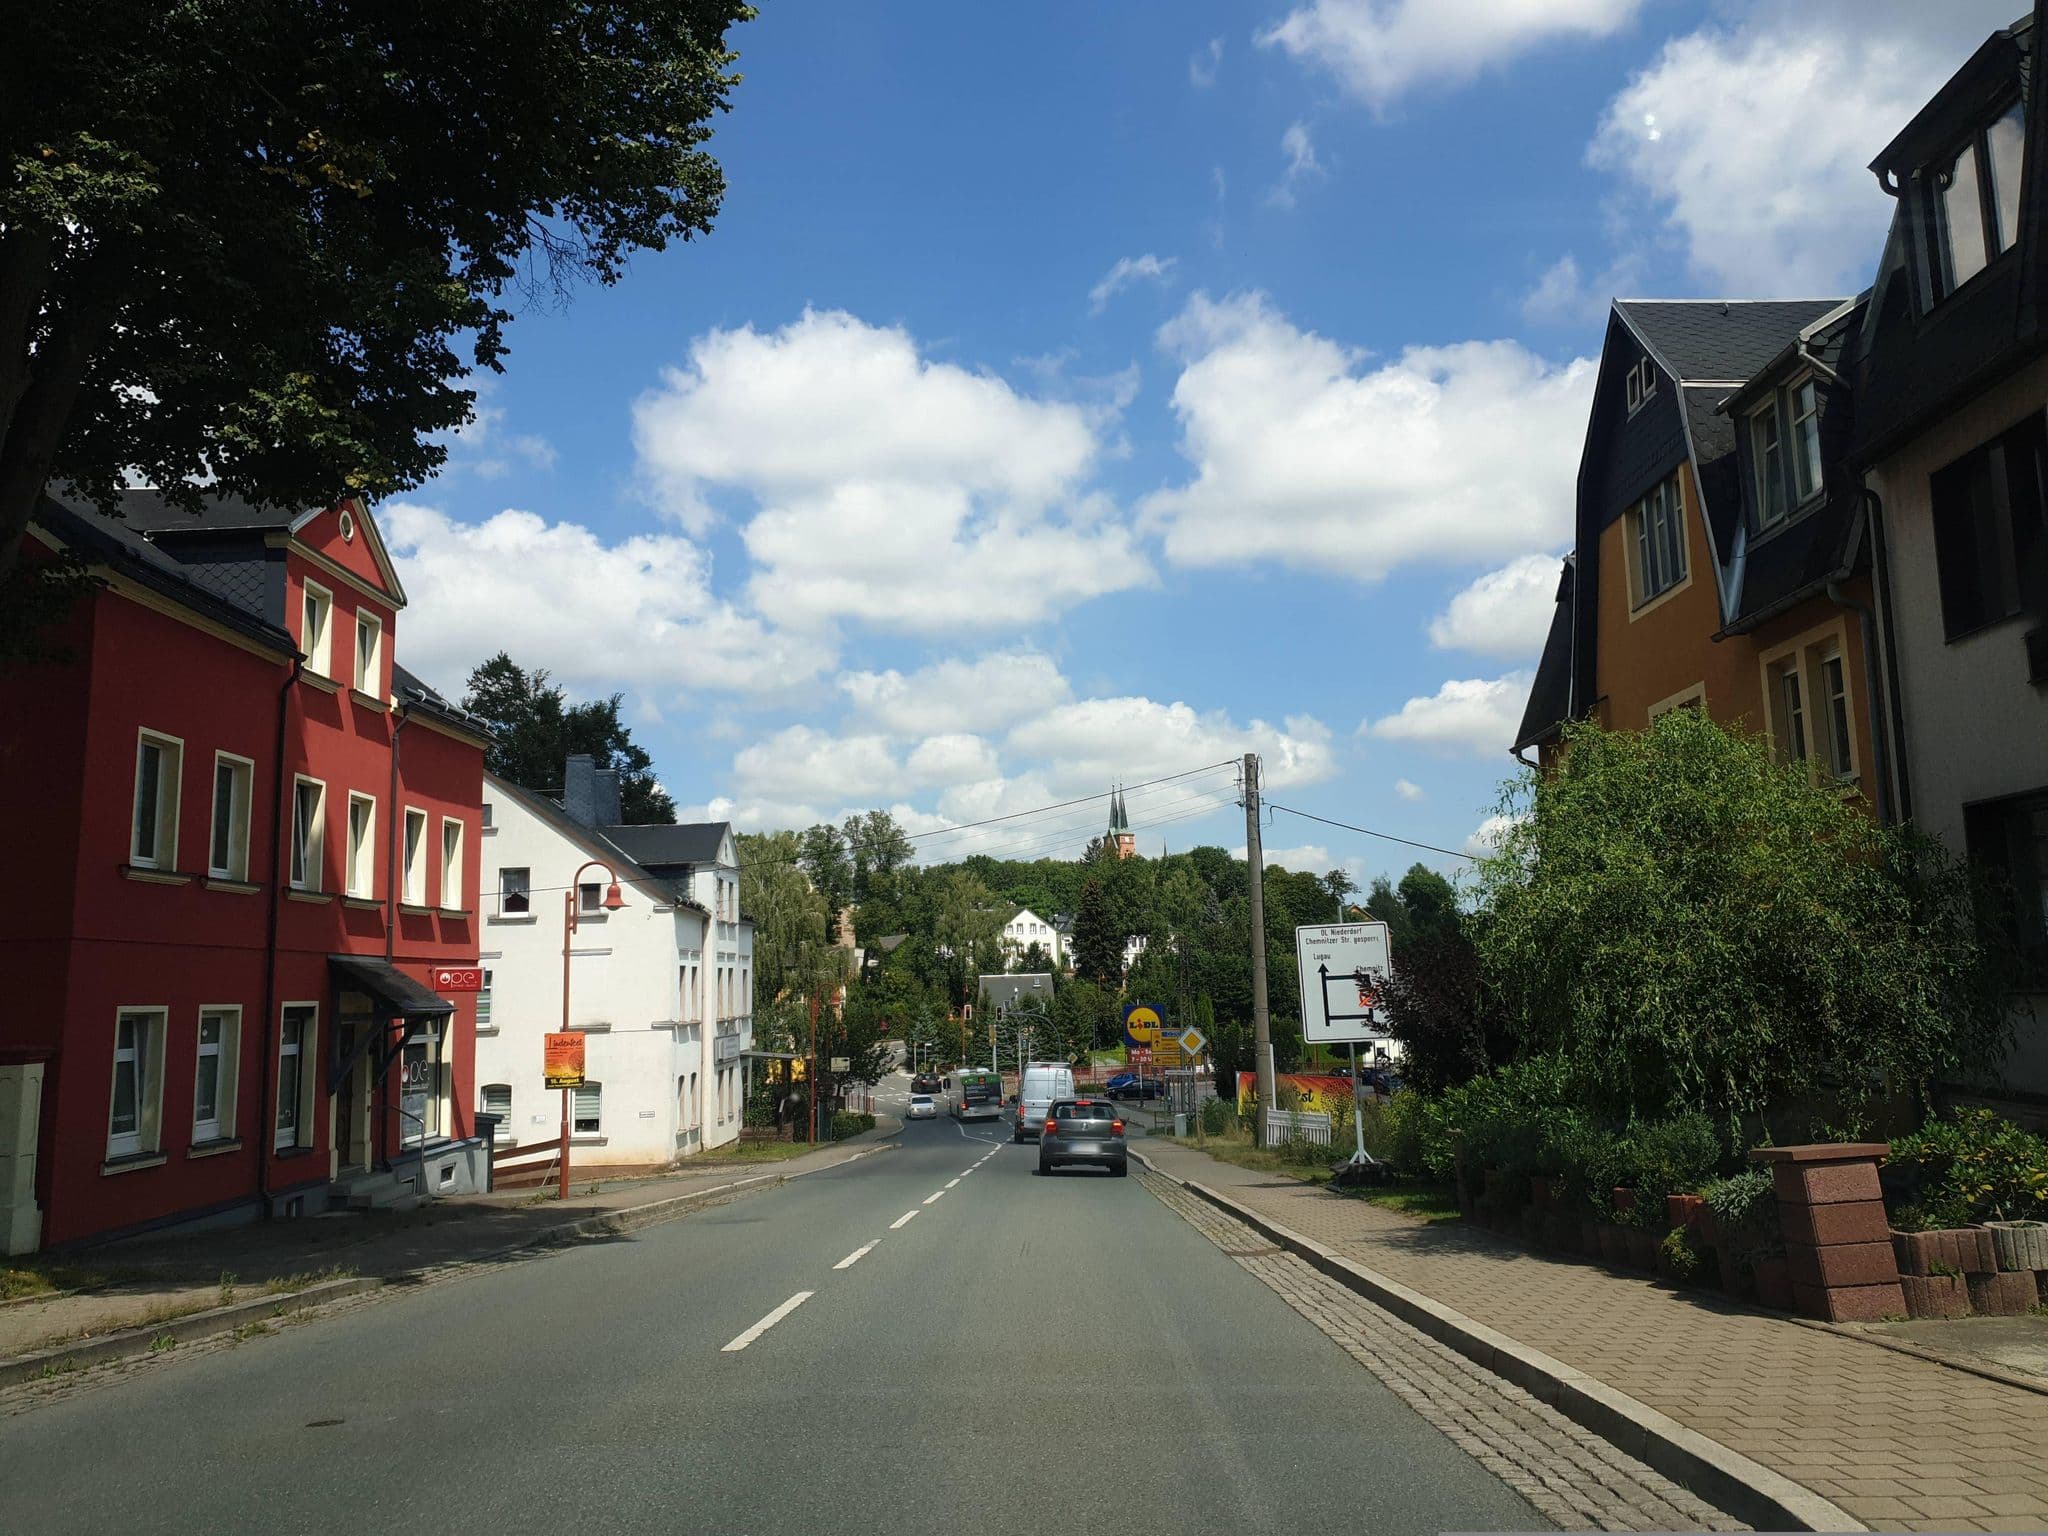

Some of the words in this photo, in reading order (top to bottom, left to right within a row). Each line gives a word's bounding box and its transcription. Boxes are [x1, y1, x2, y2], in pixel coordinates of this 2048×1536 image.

[1331, 928, 1362, 936] Niederdorf
[1305, 936, 1338, 945] Chemnitzer
[1340, 936, 1352, 944] Str.
[1313, 953, 1331, 961] Lugau
